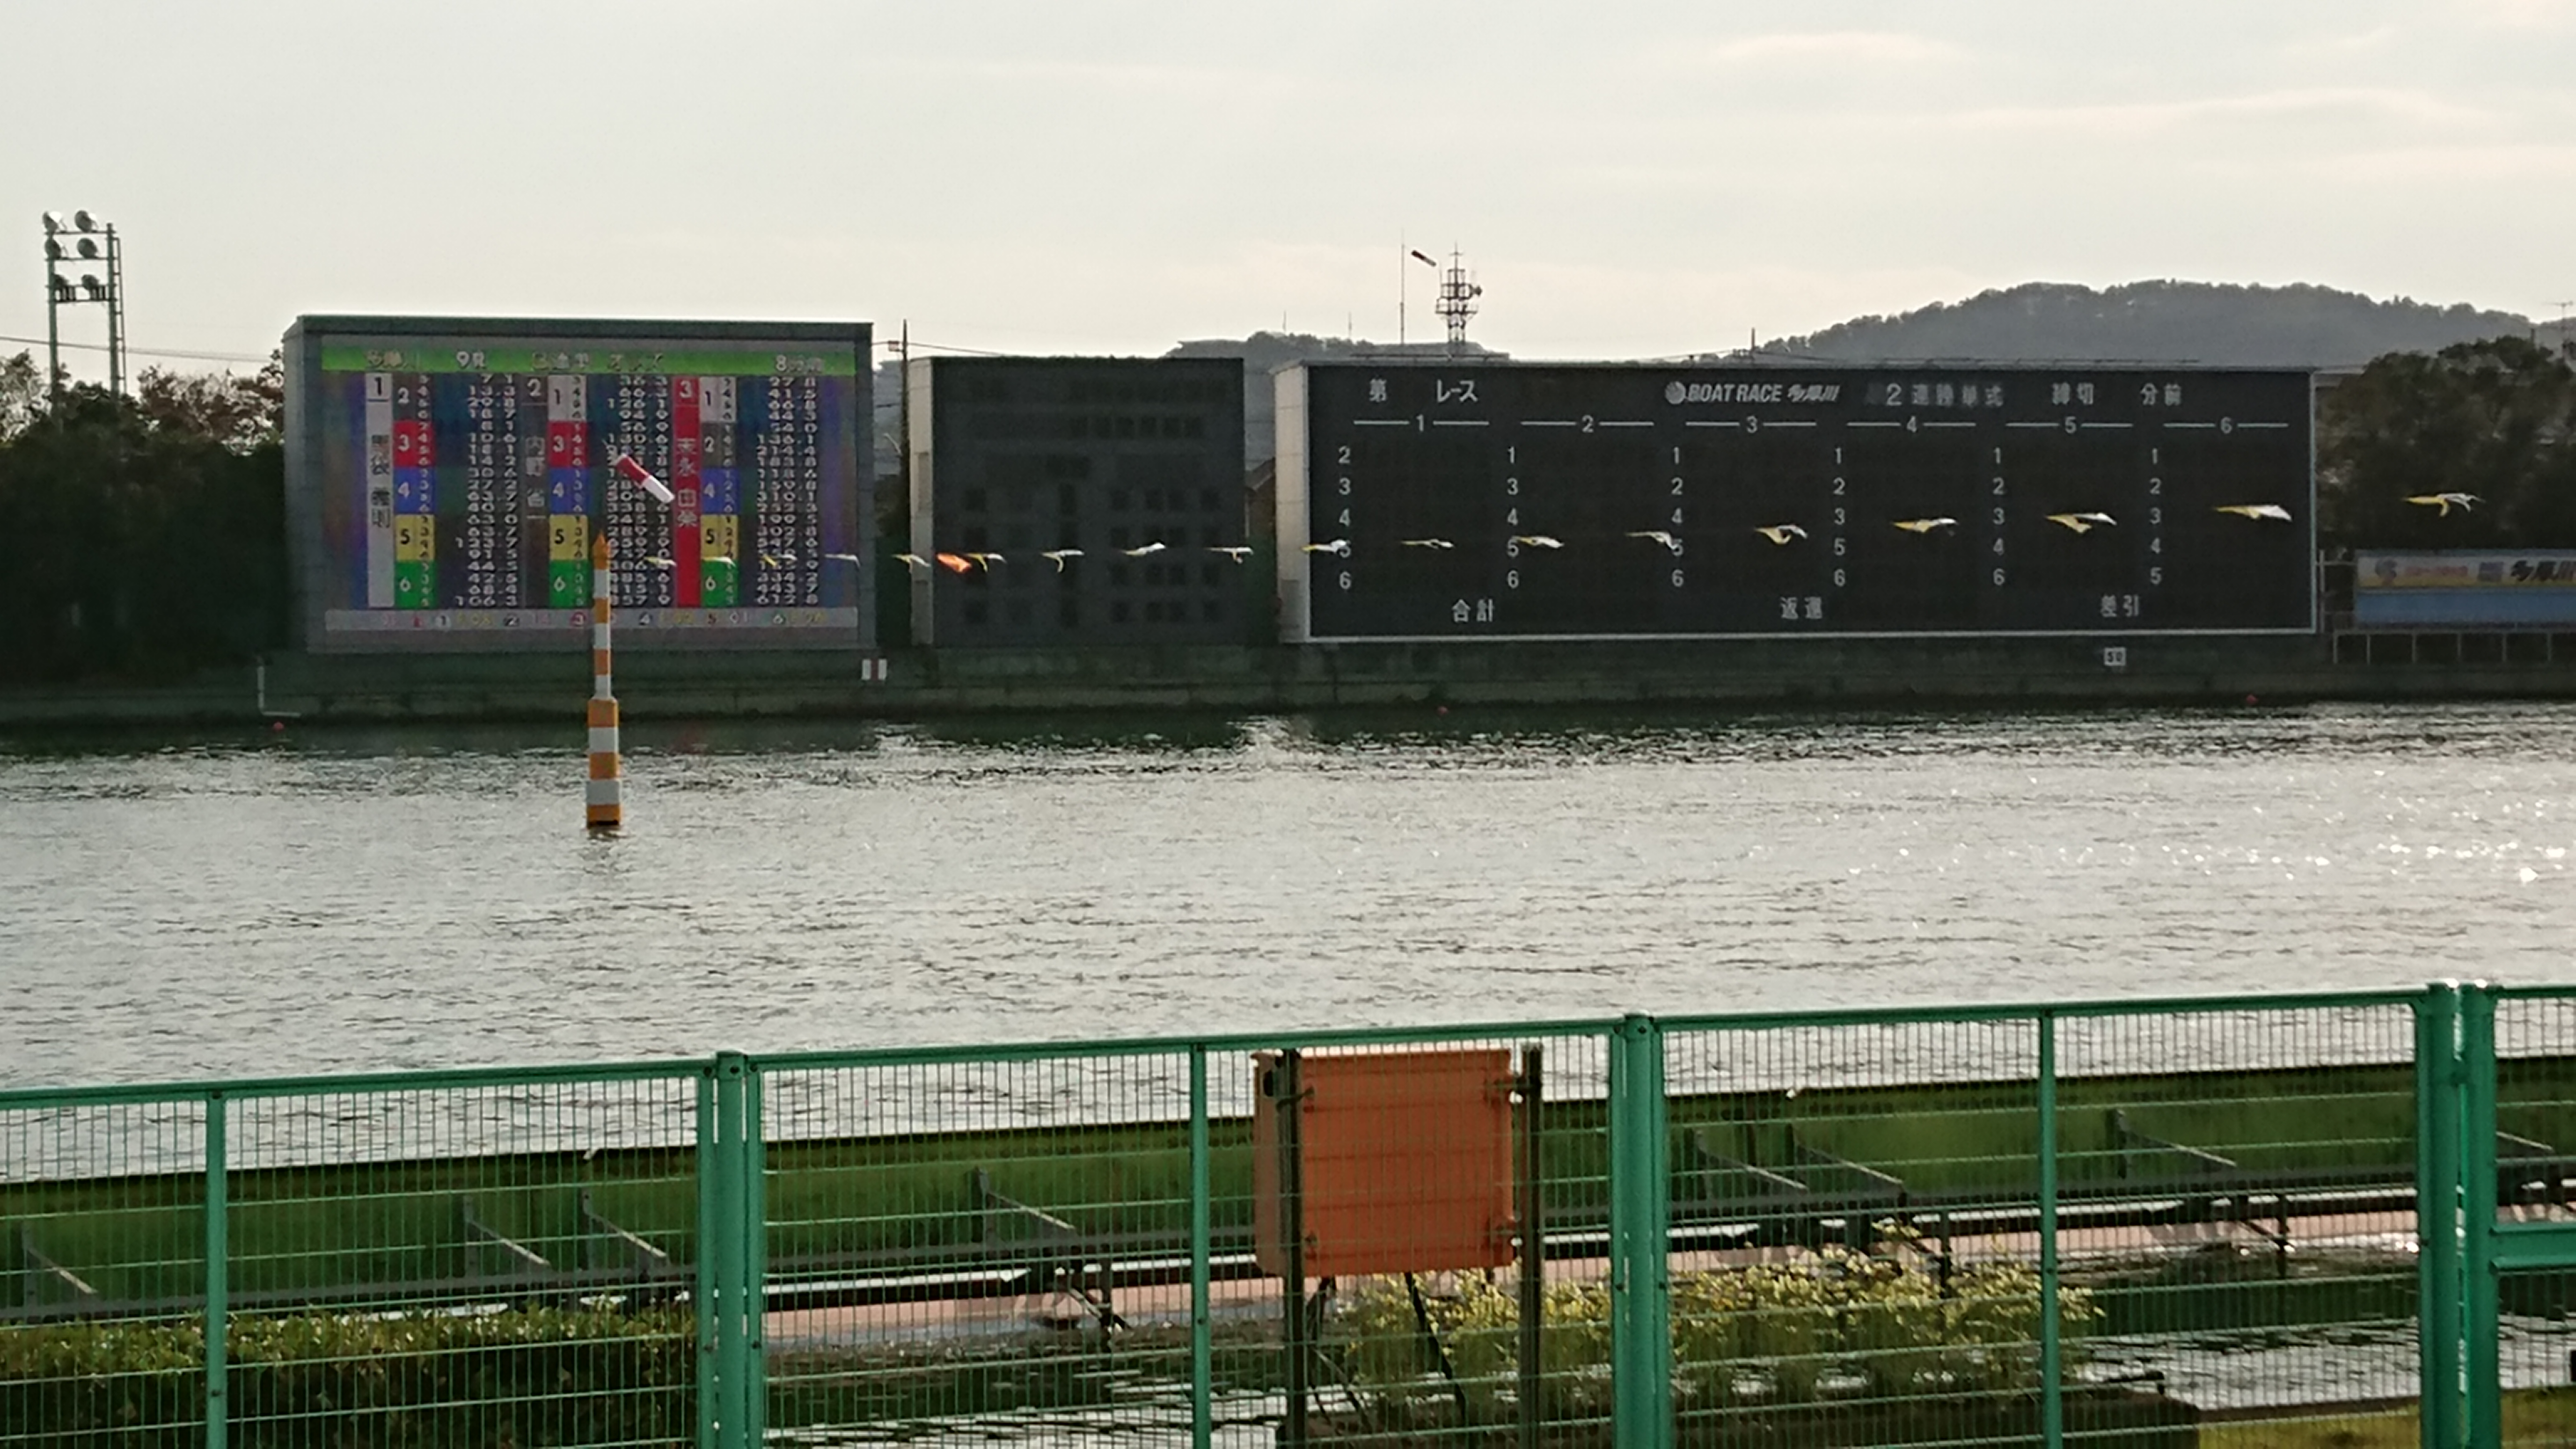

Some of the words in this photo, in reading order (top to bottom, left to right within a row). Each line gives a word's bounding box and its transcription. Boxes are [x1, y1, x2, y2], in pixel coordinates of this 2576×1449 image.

[456, 352, 485, 368] 9R
[374, 377, 383, 395] 1
[527, 378, 542, 396] 2
[680, 380, 693, 398] 3
[1369, 378, 1387, 402] 第
[1436, 379, 1478, 402] レース
[1689, 384, 1735, 402] BOAT
[1735, 384, 1782, 402] RACE
[398, 388, 410, 404] 2
[554, 388, 561, 404] 1
[704, 390, 711, 406] 1
[1416, 414, 1425, 432] 1
[1582, 415, 1593, 432] 2
[1746, 416, 1757, 433] 3
[1906, 416, 1917, 433] 4
[2065, 418, 2076, 433] 5
[2221, 418, 2232, 433] 6
[398, 434, 410, 451] 3
[553, 435, 564, 452] 3
[704, 436, 715, 452] 2
[1339, 446, 1350, 463] 2
[1508, 446, 1515, 463] 1
[1674, 447, 1679, 463] 1
[1836, 448, 1841, 463] 1
[1995, 448, 2000, 463] 1
[2152, 448, 2157, 463] 1
[398, 482, 410, 498] 4
[553, 482, 564, 497] 4
[703, 482, 715, 498] 4
[1339, 478, 1350, 495] 3
[1508, 478, 1518, 495] 3
[1672, 477, 1683, 495] 2
[1834, 477, 1845, 495] 2
[1993, 477, 2004, 494] 2
[2151, 478, 2160, 494] 2
[1339, 509, 1350, 526] 4
[1508, 508, 1518, 525] 4
[1672, 508, 1682, 523] 4
[1835, 508, 1844, 525] 3
[1993, 508, 2004, 524] 3
[2151, 508, 2160, 524] 3
[400, 528, 410, 544] 5
[555, 528, 564, 544] 5
[705, 528, 715, 544] 5
[1508, 540, 1519, 557] 5
[1835, 538, 1845, 555] 5
[1993, 538, 2003, 555] 4
[2151, 538, 2160, 553] 4
[704, 576, 716, 591] 6
[1340, 571, 1351, 589] 6
[1508, 571, 1518, 588] 6
[1672, 570, 1683, 586] 6
[1835, 569, 1845, 586] 6
[1994, 569, 2005, 585] 6
[2151, 567, 2161, 584] 5
[400, 577, 411, 592] 6
[554, 576, 565, 592] 6
[640, 614, 651, 627] 4
[773, 613, 785, 624] 6
